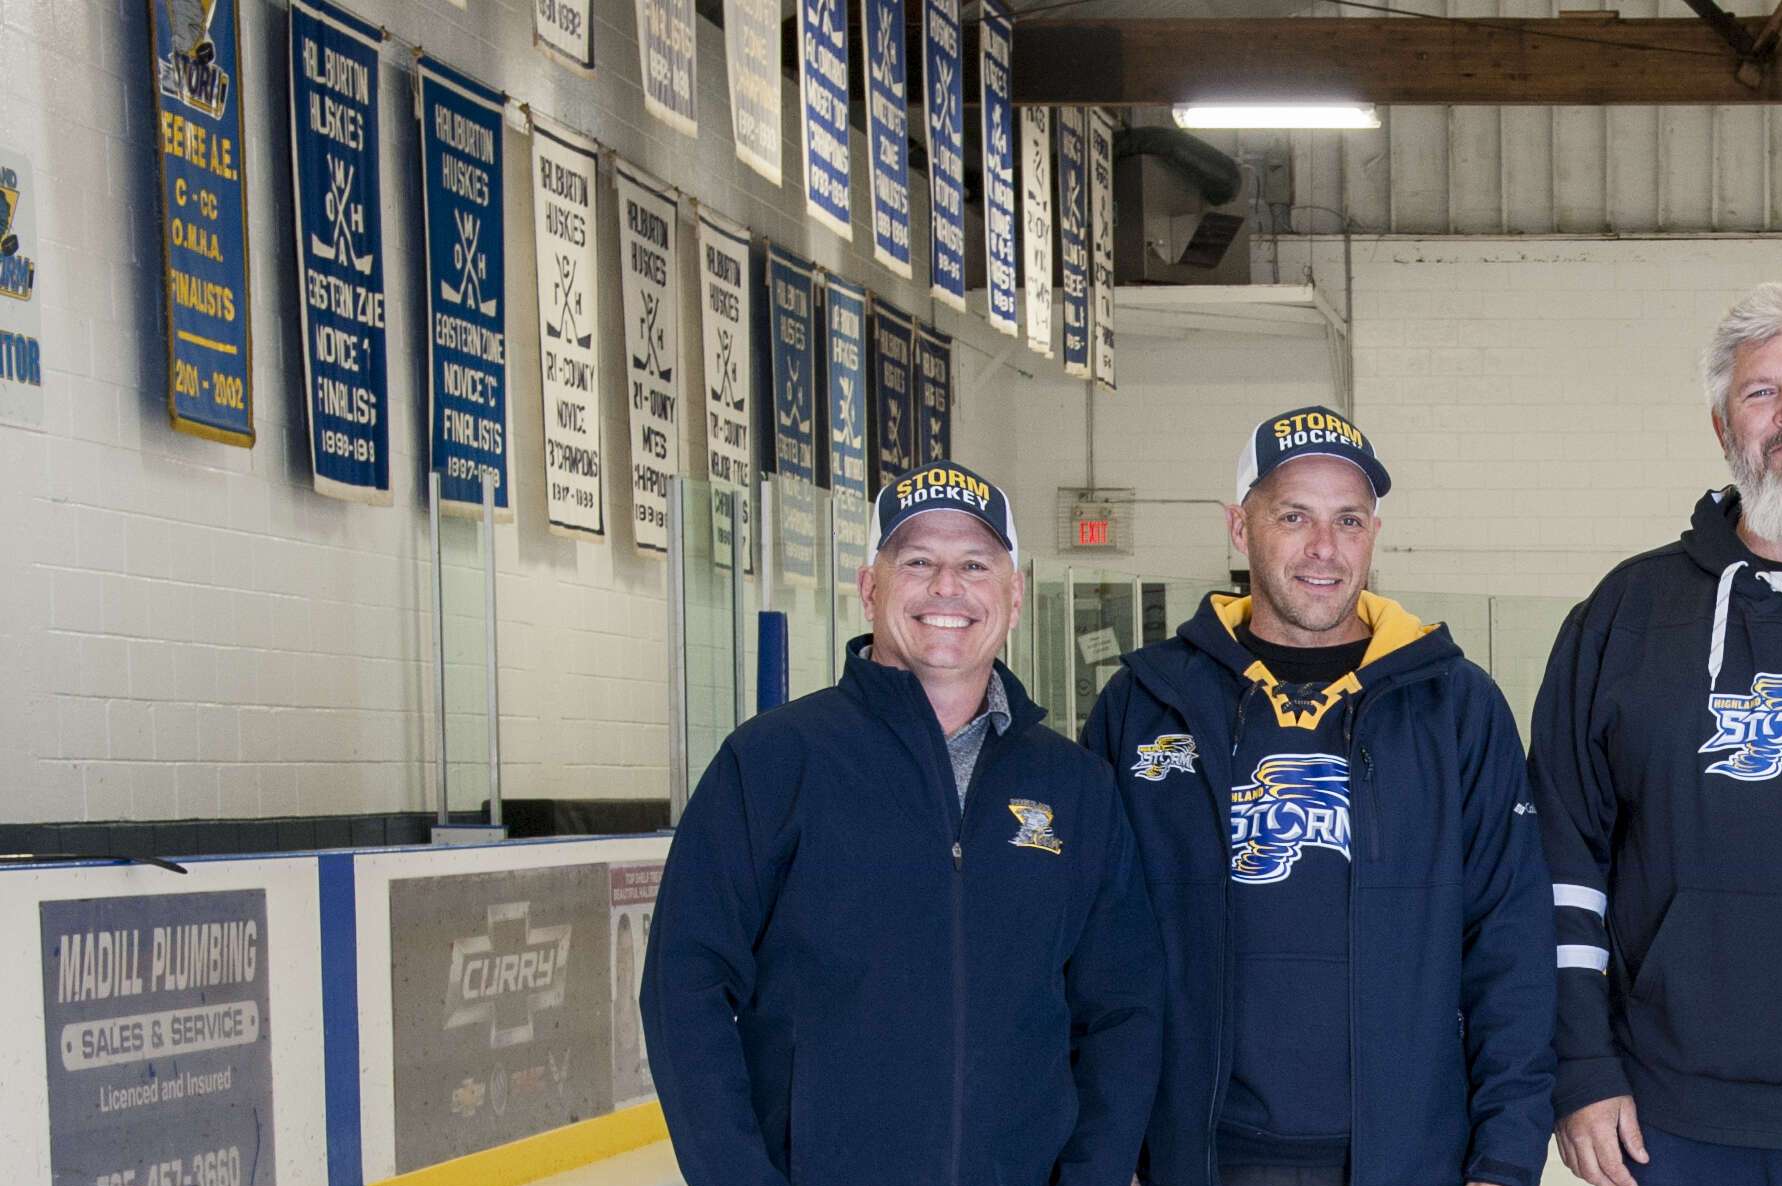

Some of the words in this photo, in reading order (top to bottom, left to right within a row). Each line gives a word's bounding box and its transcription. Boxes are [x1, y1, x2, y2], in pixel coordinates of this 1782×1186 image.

[303, 37, 369, 105] HALBURTON
[175, 178, 187, 206] C
[200, 189, 218, 219] CC
[442, 152, 489, 207] HUSKIES
[171, 269, 235, 321] FINALISTS
[436, 312, 481, 357] EASTERN
[443, 360, 484, 403] NOVICE
[443, 408, 502, 455] FINALISTS
[1273, 412, 1363, 448] STORM
[896, 468, 991, 502] STORM
[899, 486, 988, 511] HOCKEY
[1078, 520, 1109, 545] EXIT
[1713, 698, 1761, 710] HIGHLAND
[58, 928, 143, 1003] MADILL
[151, 920, 257, 993] PLUMBING
[463, 948, 555, 1000] CURRY
[82, 1022, 144, 1059] SALES
[151, 1019, 165, 1049] &
[171, 1009, 243, 1046] SERVICE
[101, 1076, 159, 1113] Licenced
[161, 1070, 184, 1100] and
[187, 1065, 232, 1096] Insured
